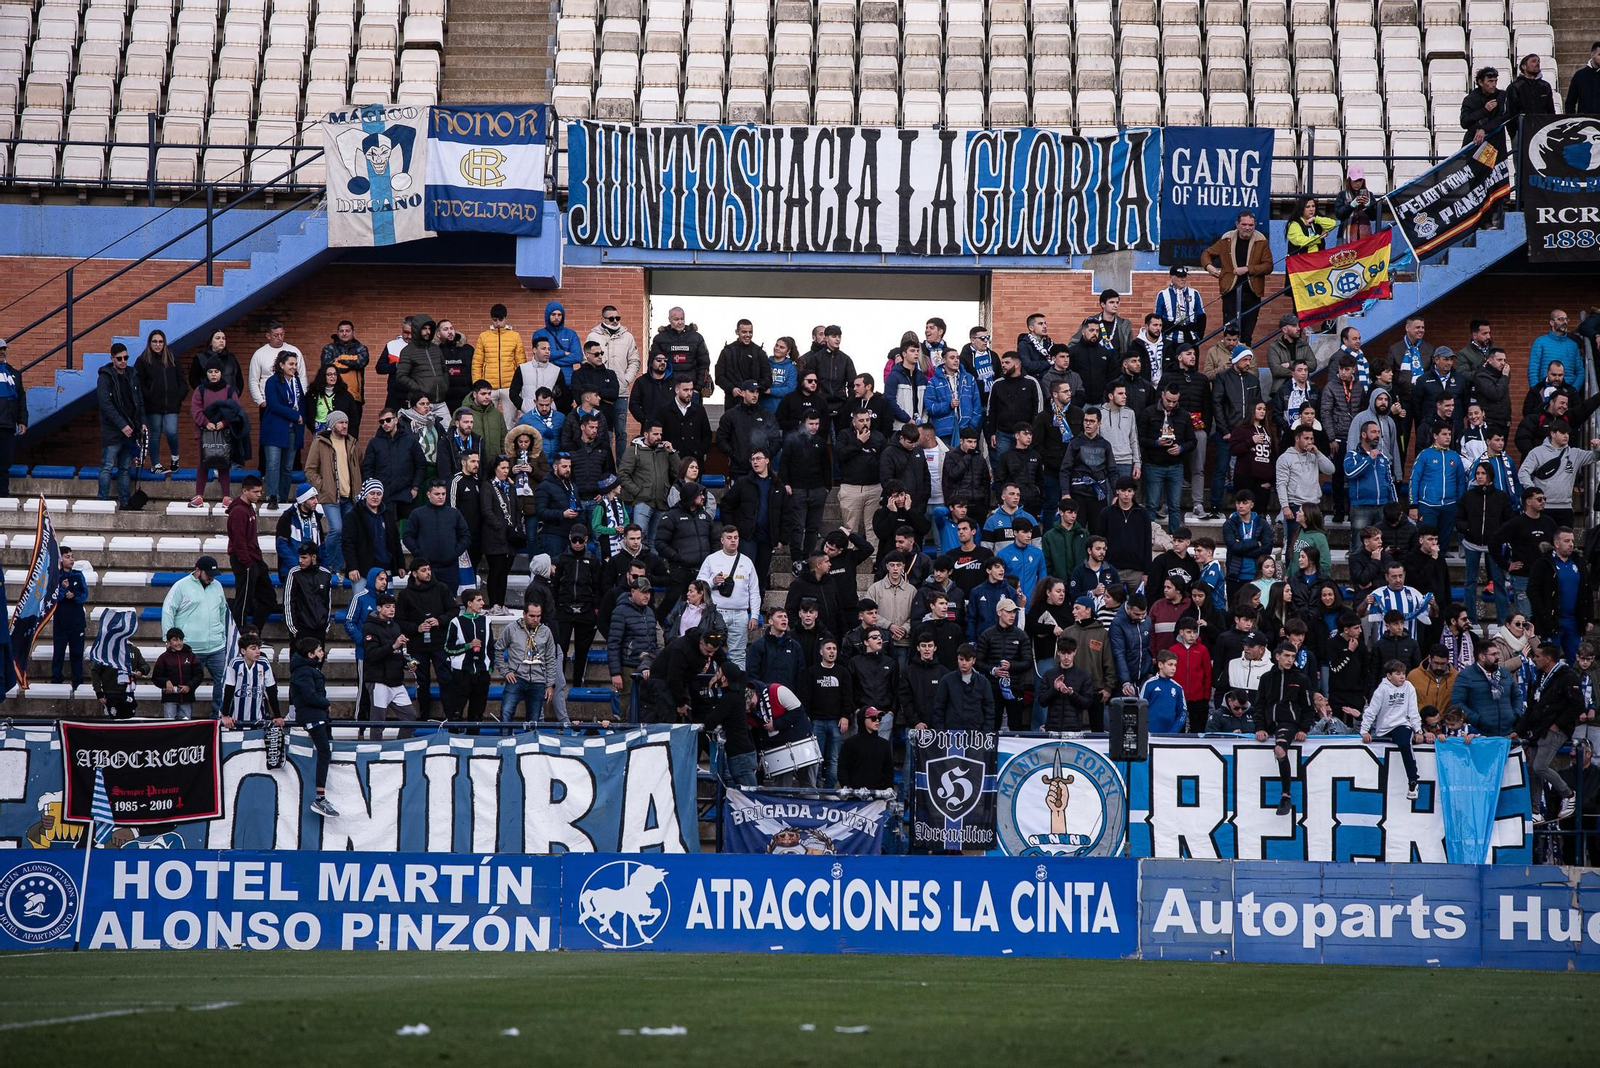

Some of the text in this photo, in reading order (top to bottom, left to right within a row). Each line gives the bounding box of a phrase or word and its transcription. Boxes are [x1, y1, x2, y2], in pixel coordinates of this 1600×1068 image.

[434, 108, 538, 137] HONOR
[1171, 147, 1261, 187] GANG
[569, 119, 1154, 255] JUNTOS HACIA LA GLORIA
[1172, 185, 1259, 207] OF HUELVA
[336, 193, 422, 214] DECANO
[1543, 229, 1600, 251] 188
[1304, 281, 1327, 297] 18
[1256, 444, 1270, 458] 95
[912, 728, 996, 750] Onuba
[76, 745, 206, 770] ABOCREW
[999, 752, 1041, 799] MANU
[1074, 751, 1118, 797] FORTI
[111, 785, 179, 797] Siempre Presente
[114, 801, 138, 812] 1985
[149, 799, 173, 811] 2010
[731, 803, 879, 838] BRIGADA JOVEN
[914, 821, 994, 844] Adrenaline
[23, 865, 53, 874] ALONSO
[112, 856, 532, 905] HOTEL MARTÍN
[685, 876, 1121, 935] ATRACCIONES LA CINTA
[1152, 887, 1466, 949] Autoparts
[22, 913, 73, 941] APARTAMENTO
[88, 906, 551, 951] ALONSO PINZÓN
